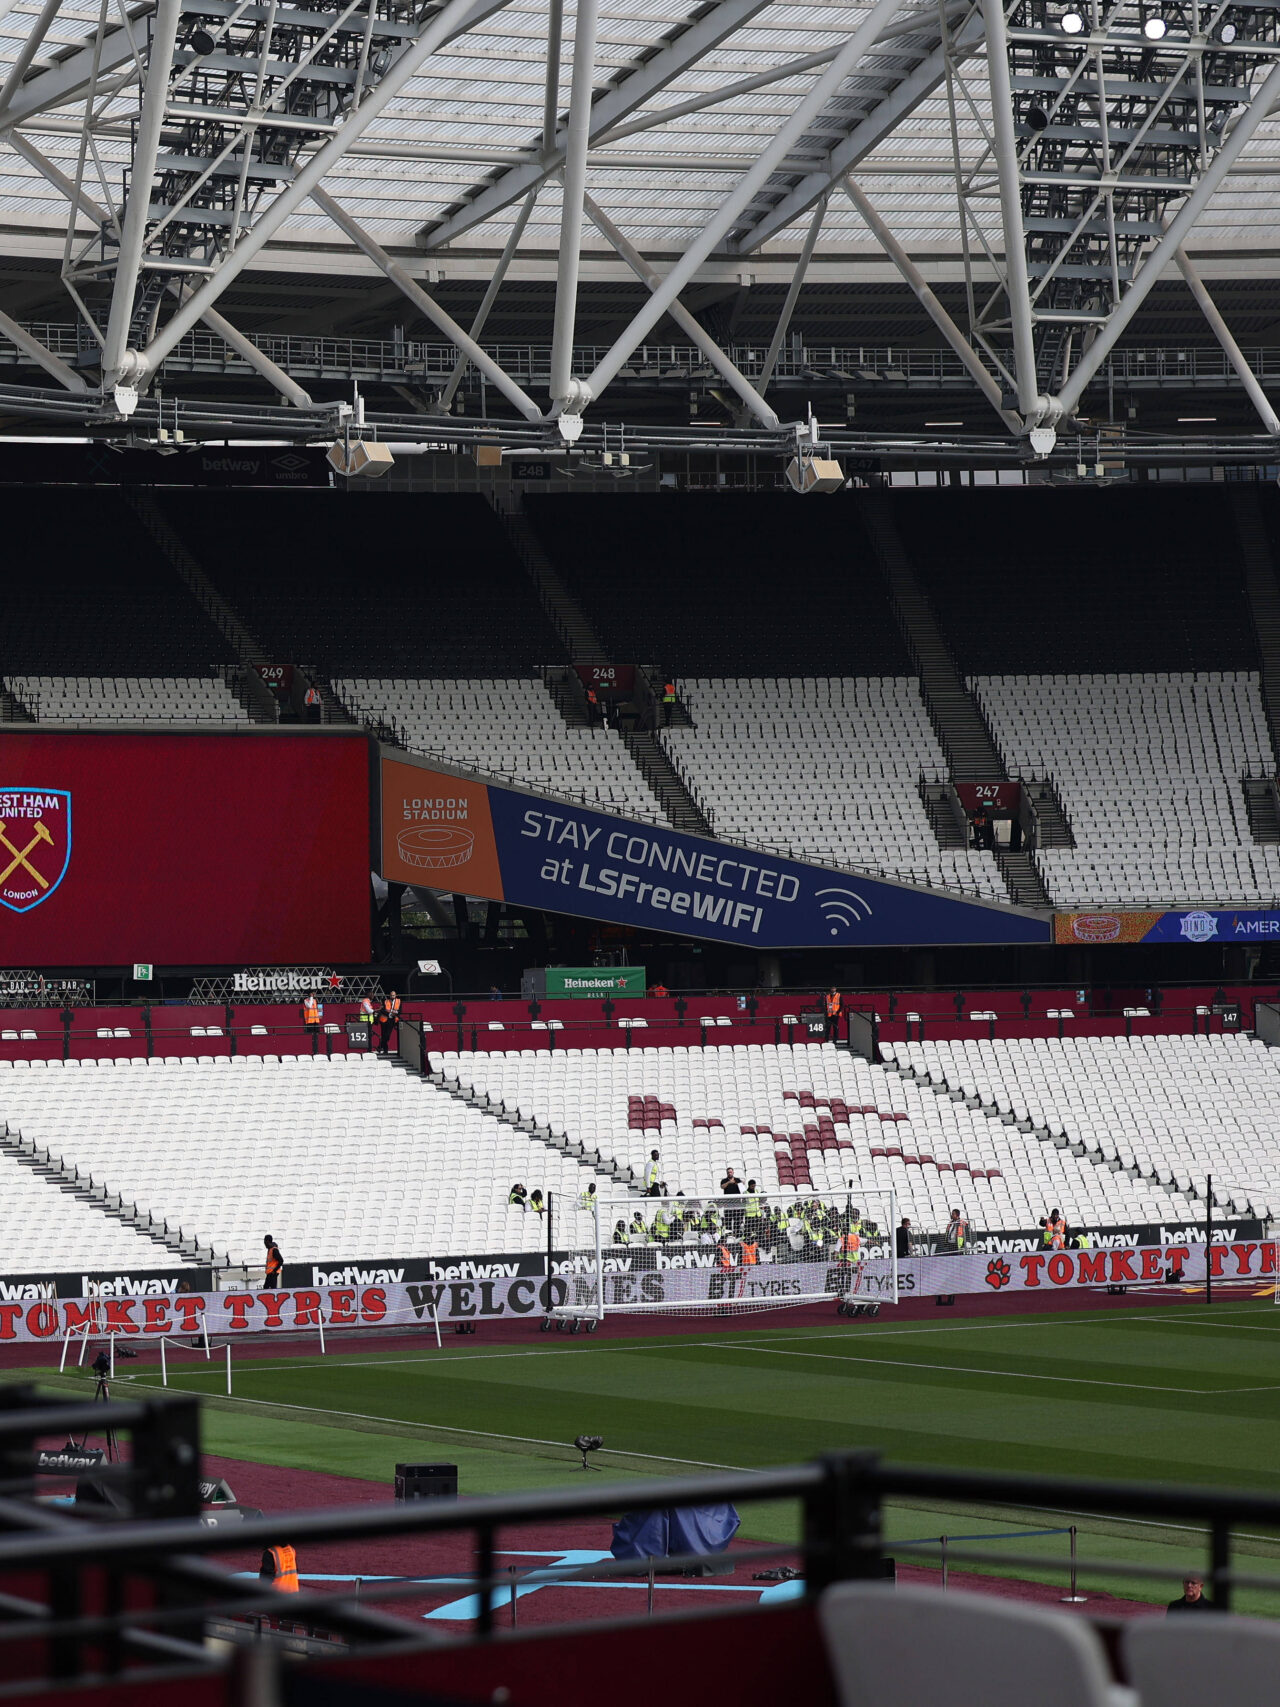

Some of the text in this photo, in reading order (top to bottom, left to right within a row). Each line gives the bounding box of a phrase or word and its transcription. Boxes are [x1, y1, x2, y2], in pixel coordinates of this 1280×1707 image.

[201, 456, 260, 474] betway
[518, 465, 544, 477] 248
[849, 459, 873, 469] 247
[275, 471, 308, 480] umbro
[261, 667, 283, 678] 249
[592, 667, 616, 679] 248
[975, 785, 1000, 798] 247
[23, 794, 60, 810] HAM
[403, 798, 468, 809] LONDON
[403, 810, 468, 820] STADIUM
[521, 810, 801, 903] STAY CONNECTED
[3, 888, 39, 900] LONDON
[540, 857, 764, 934] at LSFreeWIFI
[1183, 919, 1214, 932] DINO'S
[233, 972, 322, 992] Heineken
[564, 977, 614, 989] Heineken
[1223, 1013, 1237, 1022] 147
[350, 1032, 367, 1041] 152
[808, 1023, 824, 1033] 148
[1086, 1231, 1139, 1248] tway
[1159, 1227, 1238, 1245] betway
[858, 1241, 937, 1260] betay
[655, 1250, 738, 1271] betwy
[1021, 1247, 1190, 1286] TOMKET
[312, 1266, 405, 1287] betway
[428, 1260, 520, 1281] betway
[82, 1276, 179, 1298] betway
[747, 1279, 801, 1298] TYRES
[863, 1273, 916, 1292] TYRES
[224, 1288, 387, 1328] TYRES
[406, 1273, 664, 1318] WELCOMES
[37, 1452, 97, 1469] betway
